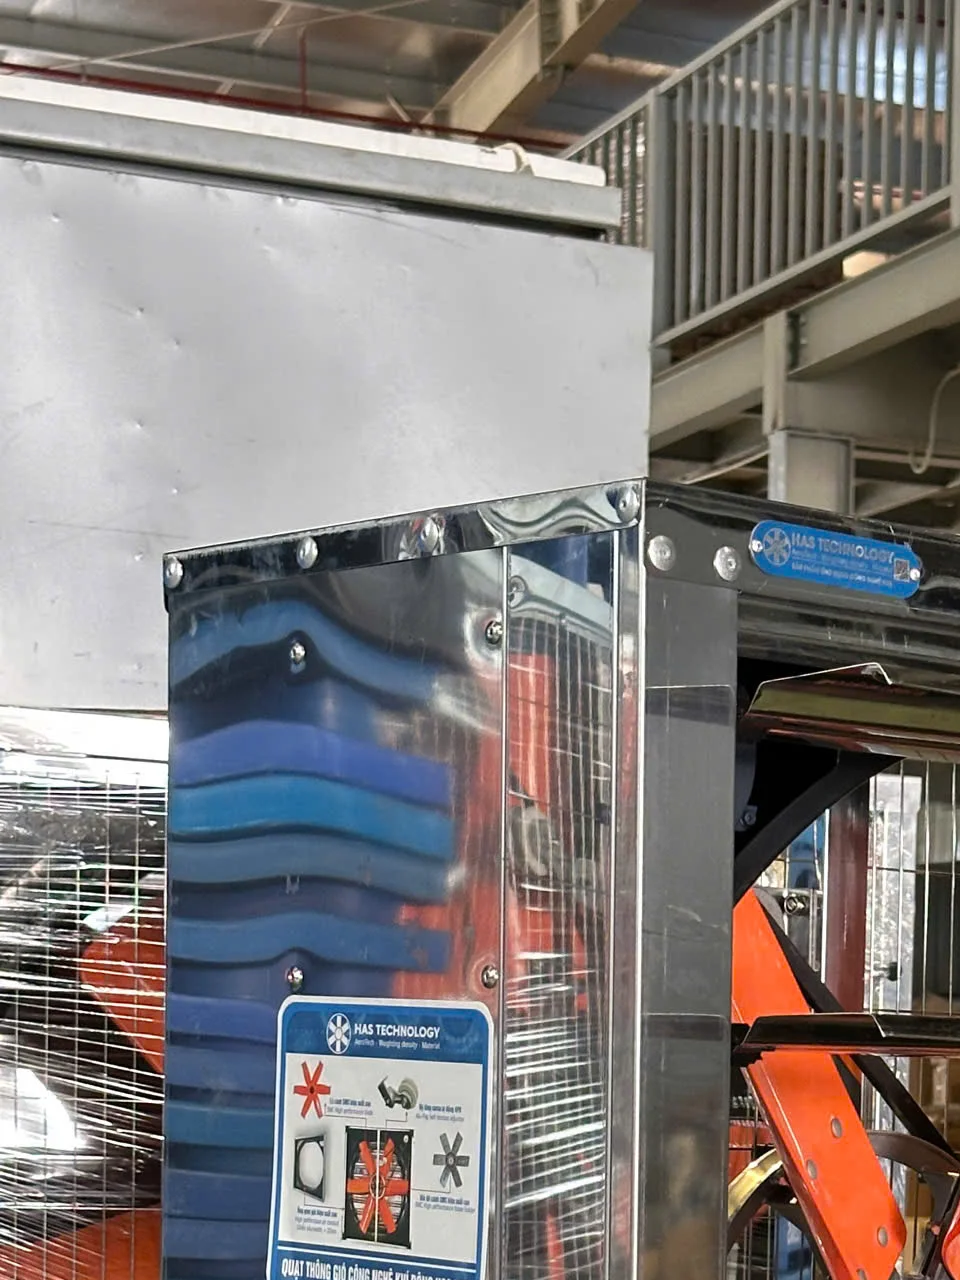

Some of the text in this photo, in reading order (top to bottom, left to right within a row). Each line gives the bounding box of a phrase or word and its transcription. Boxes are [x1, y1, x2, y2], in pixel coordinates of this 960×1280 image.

[791, 531, 815, 549] HAS
[818, 537, 894, 564] TECHNOLOGY
[354, 1023, 441, 1039] HAS TECHNOLOGY
[281, 1258, 304, 1280] QUẠT
[306, 1258, 332, 1280] THÔNG
